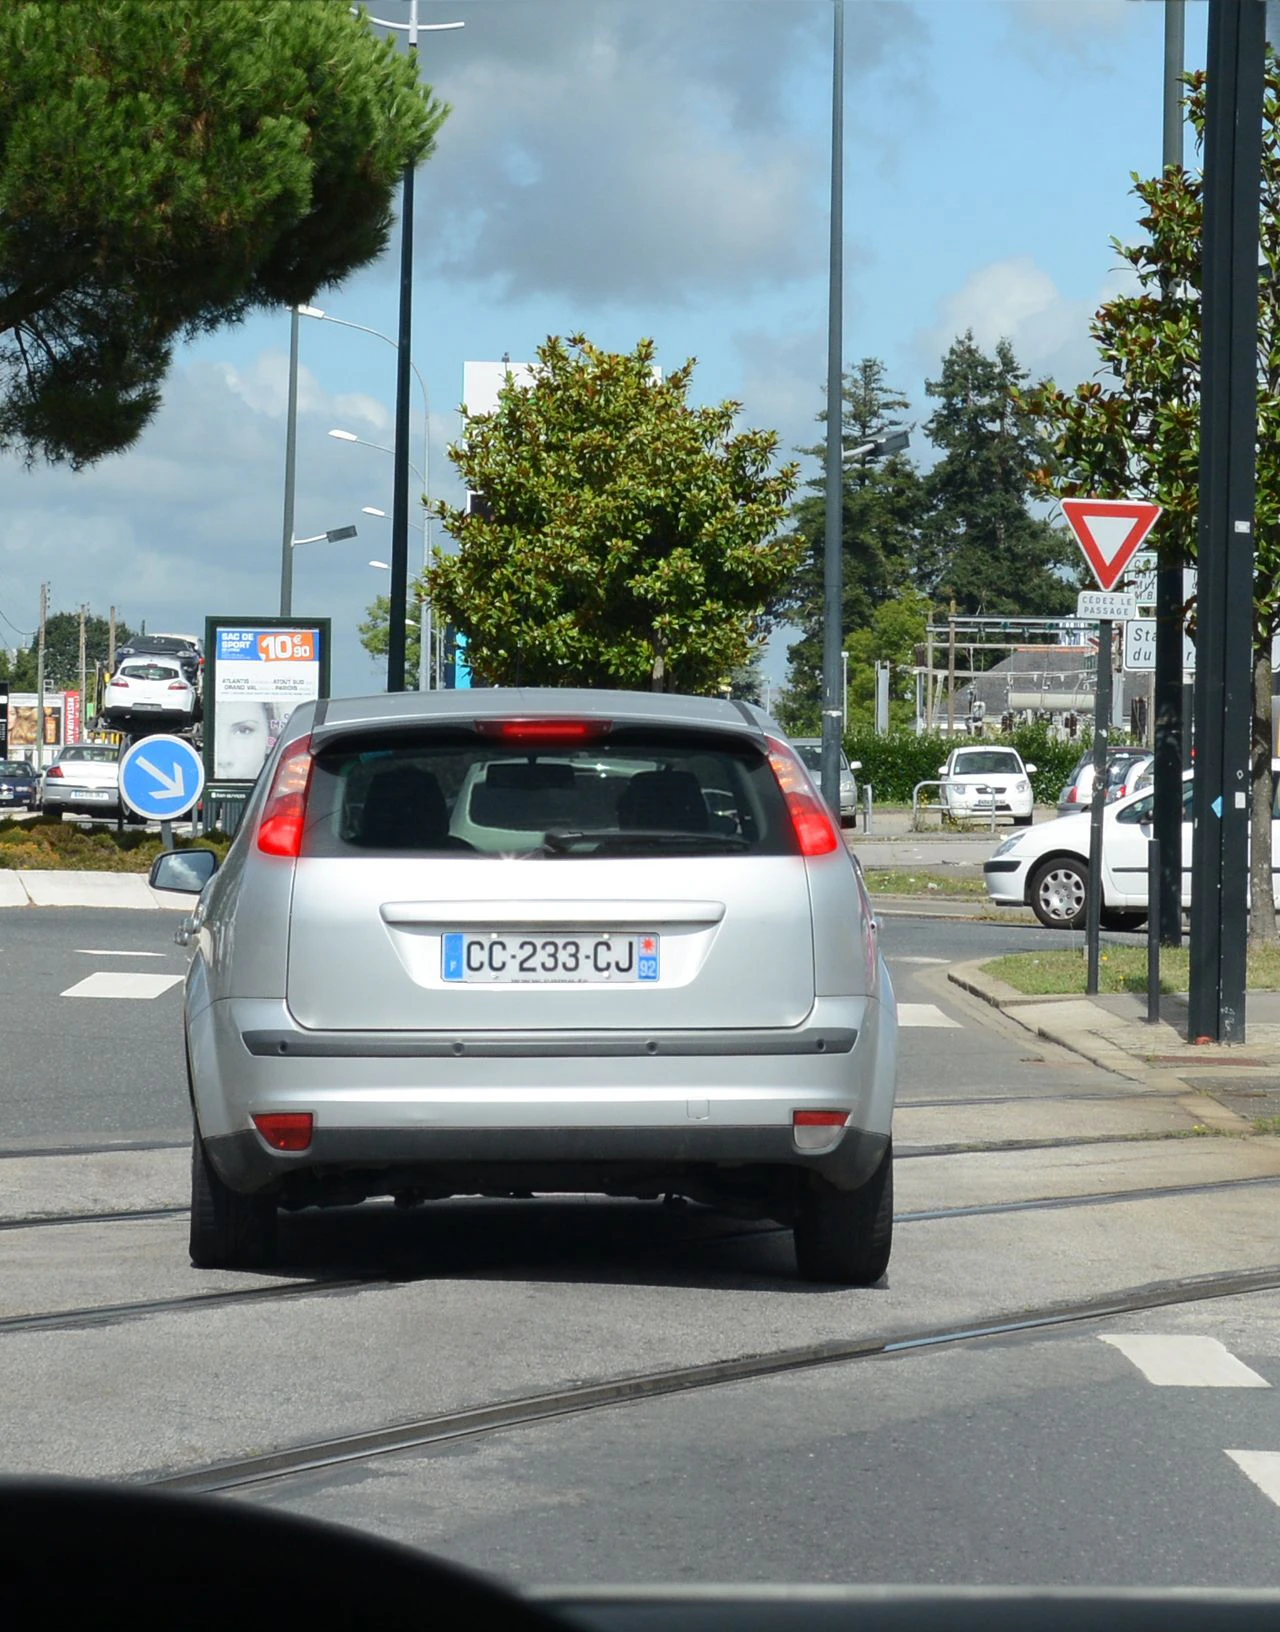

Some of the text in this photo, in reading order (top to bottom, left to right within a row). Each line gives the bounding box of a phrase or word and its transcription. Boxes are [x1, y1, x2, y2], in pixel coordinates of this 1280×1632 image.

[1082, 594, 1132, 606] CÉDEZ LE
[1084, 606, 1129, 616] PASSAGE
[222, 633, 254, 641] SAC DE
[222, 641, 251, 649] SPORT
[293, 646, 310, 658] 90
[1133, 649, 1152, 661] du
[466, 940, 634, 973] CC-233-CJ
[449, 960, 457, 972] F
[639, 960, 657, 977] 92
